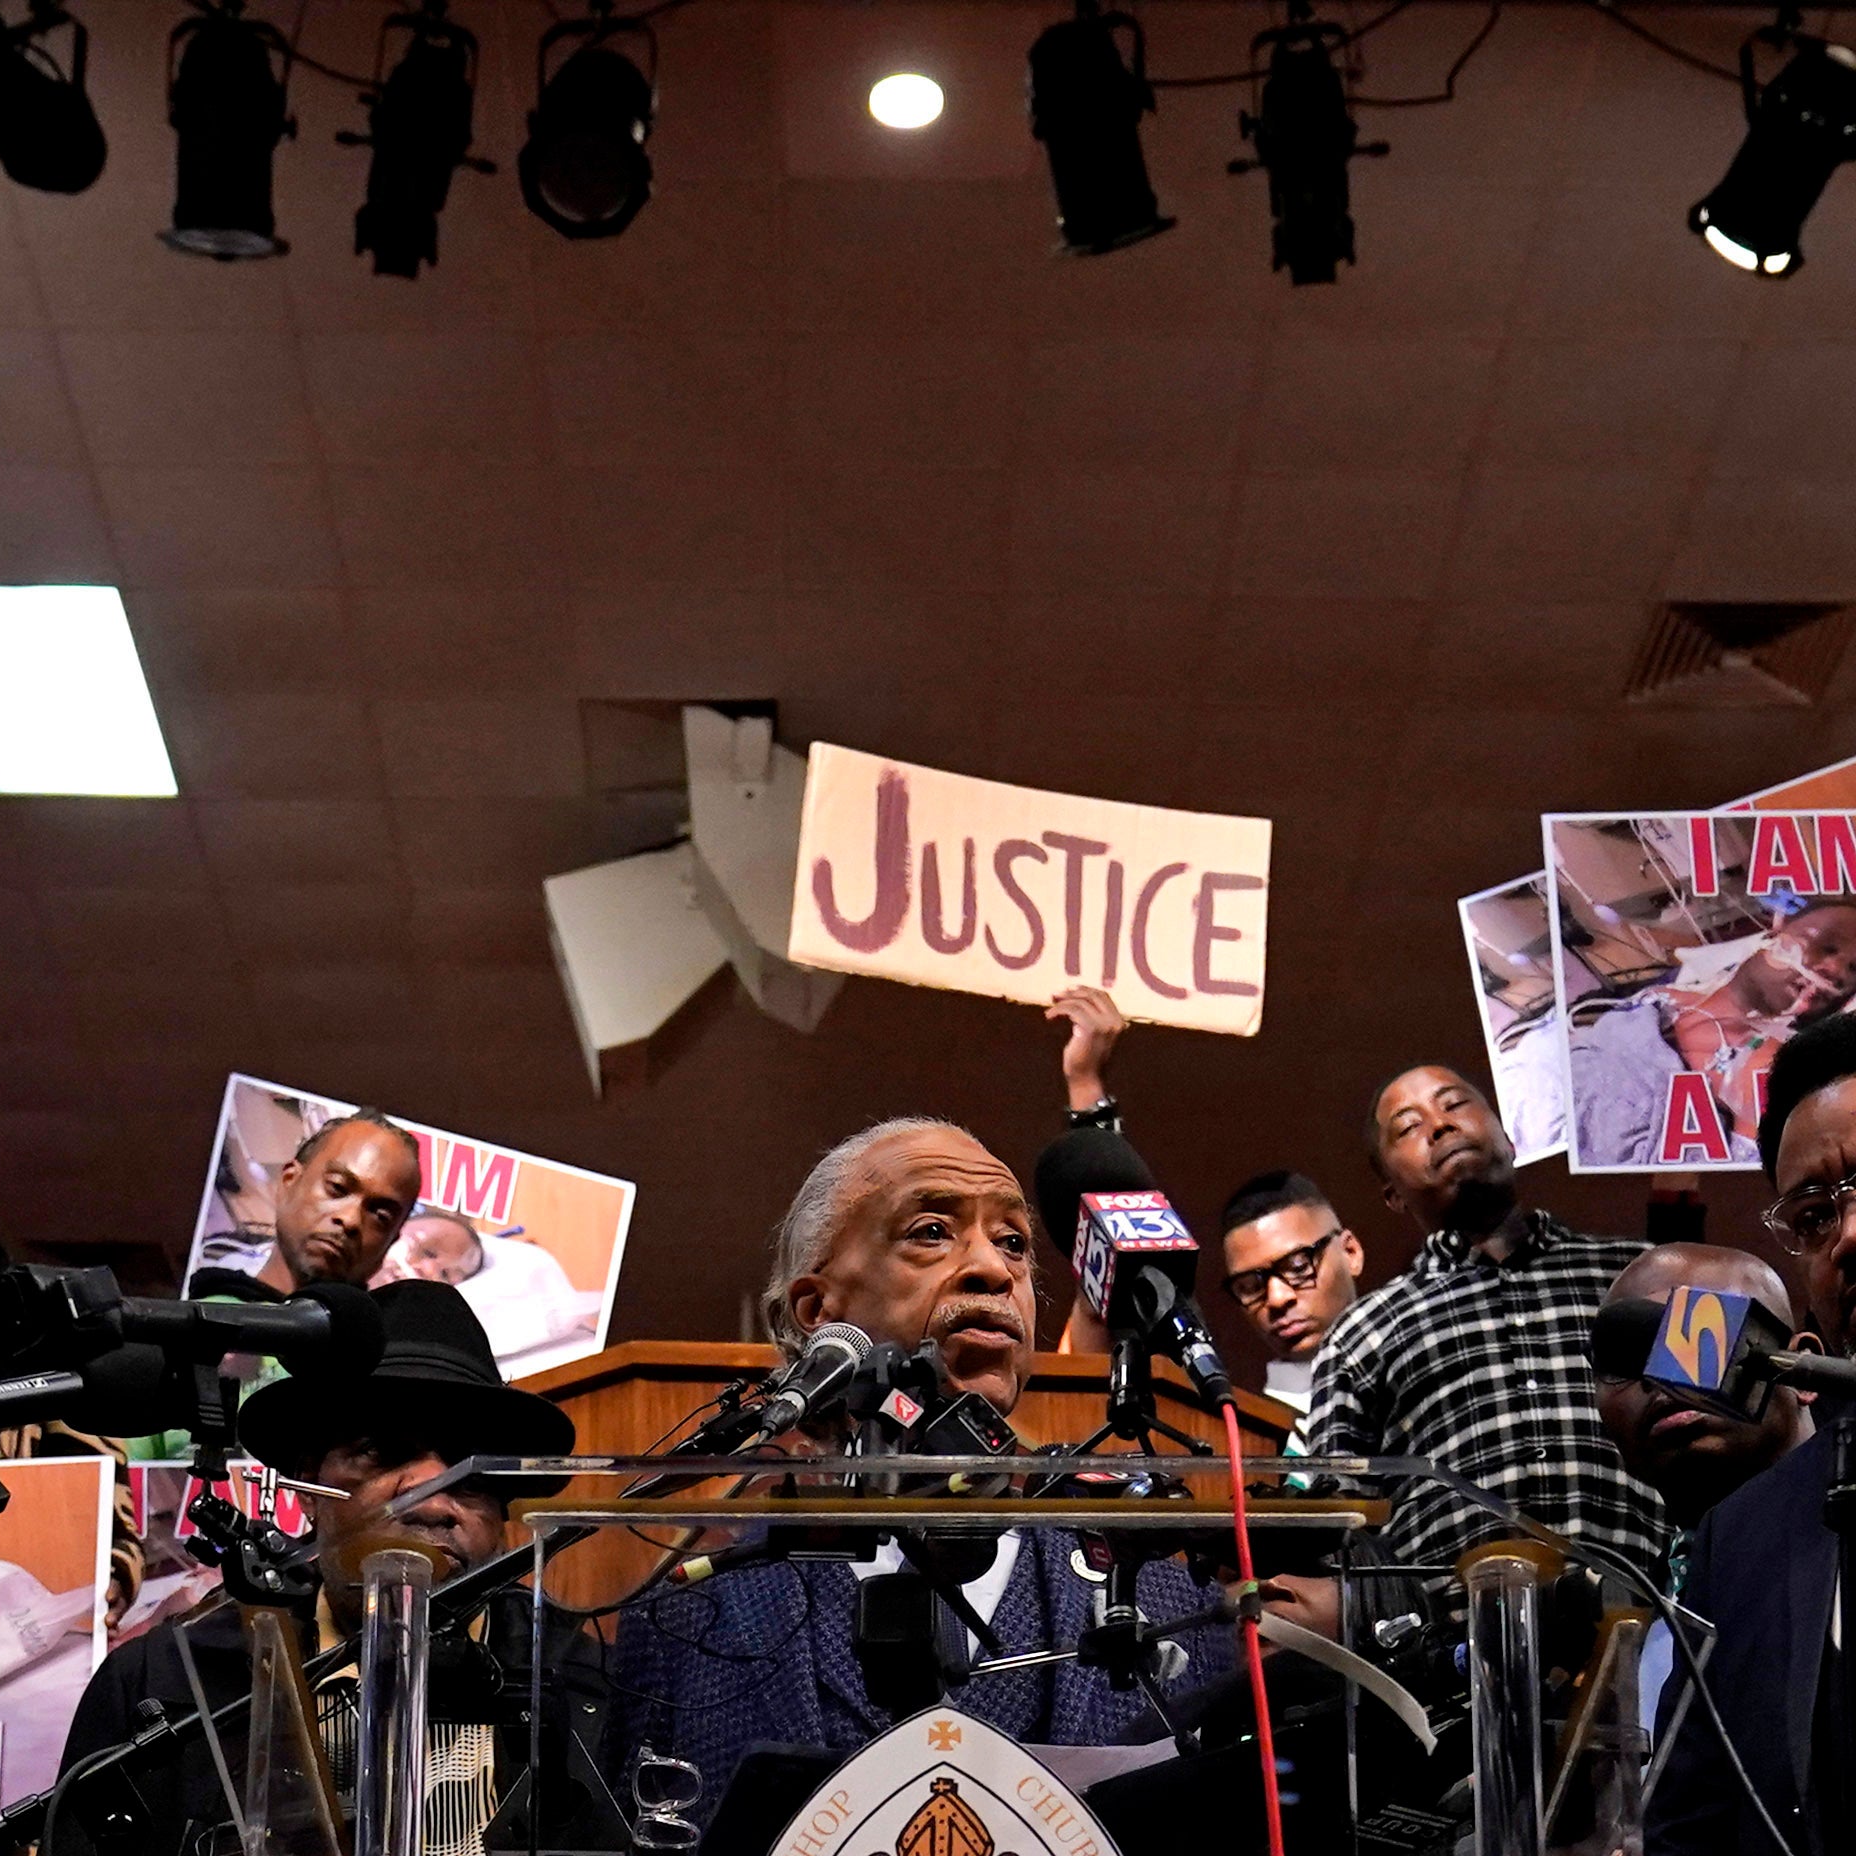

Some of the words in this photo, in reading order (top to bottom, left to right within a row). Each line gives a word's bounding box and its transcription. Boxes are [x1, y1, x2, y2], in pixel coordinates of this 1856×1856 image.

[812, 769, 1266, 1001] JUSTICE
[1687, 815, 1718, 896] I
[1658, 1071, 1732, 1163] A
[1095, 1194, 1161, 1209] FOX
[1106, 1210, 1176, 1240] 13
[1120, 1240, 1191, 1249] NEWS
[1663, 1285, 1731, 1388] 5
